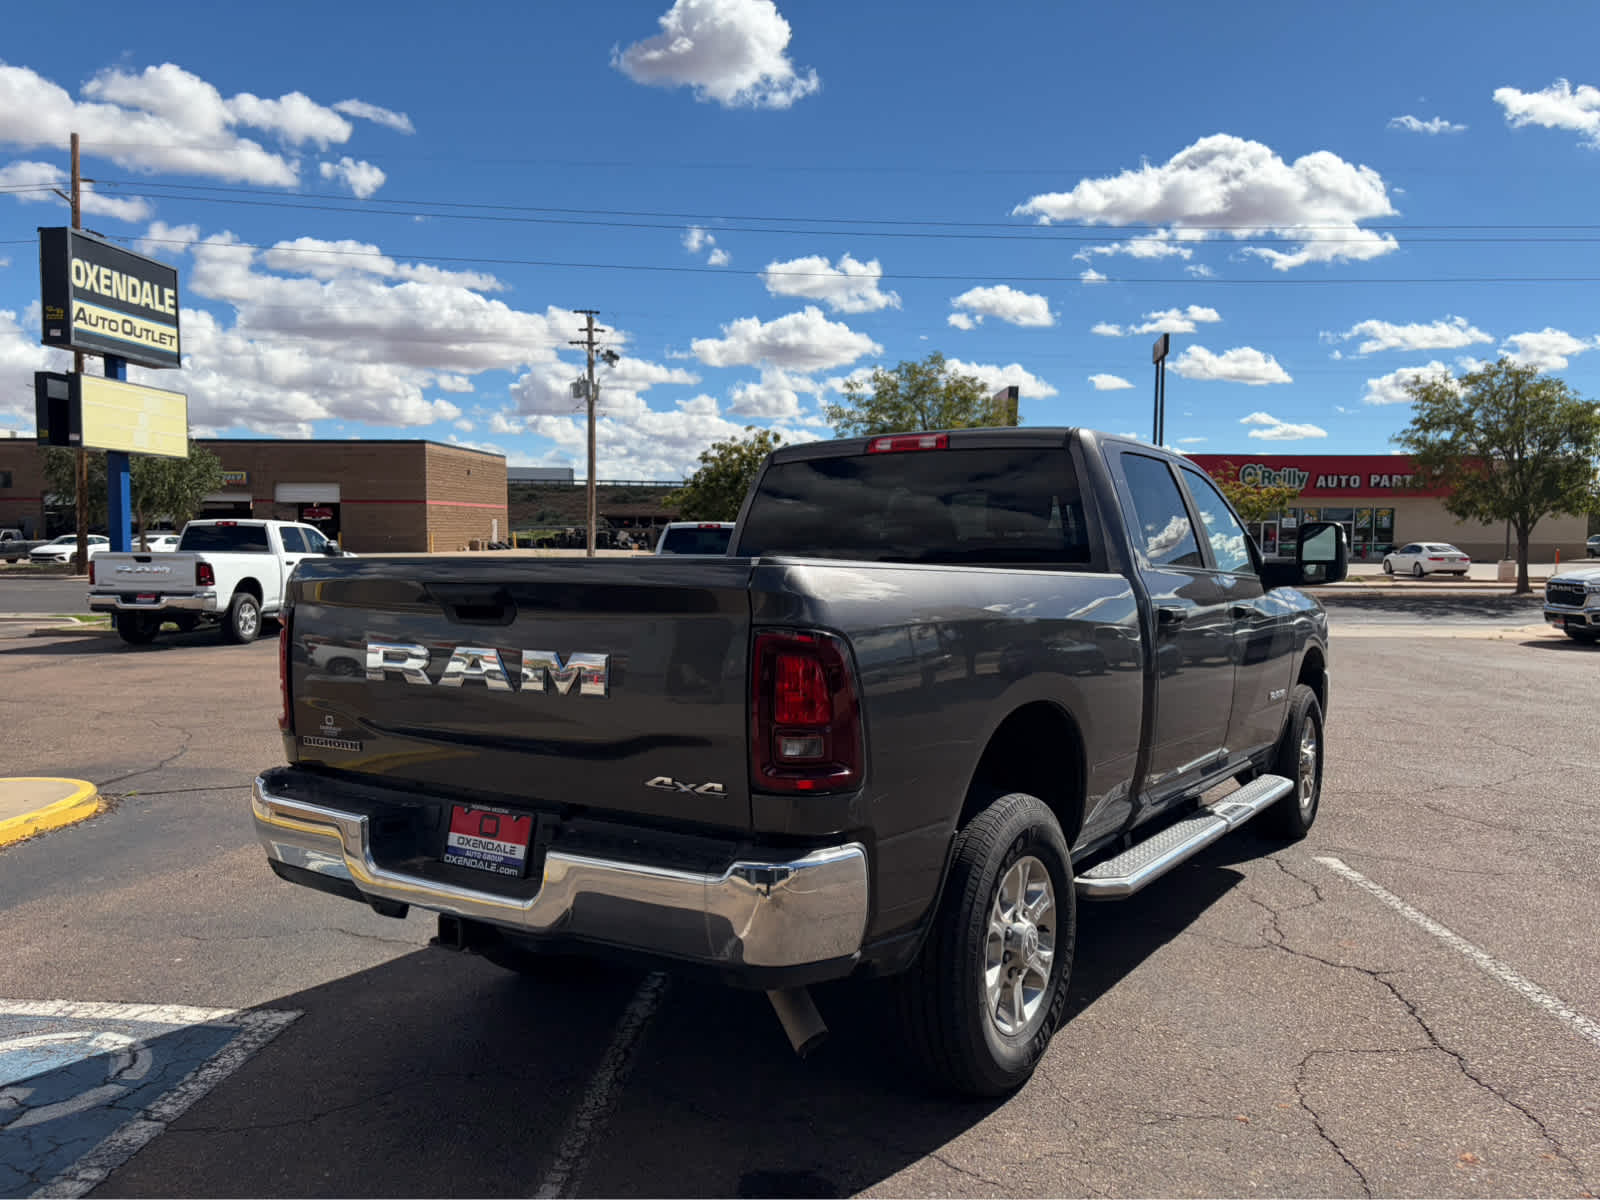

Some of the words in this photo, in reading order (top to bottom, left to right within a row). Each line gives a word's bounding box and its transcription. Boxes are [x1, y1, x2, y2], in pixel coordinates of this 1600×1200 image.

[72, 258, 176, 317] OXENDALE
[74, 307, 119, 333] AUTO
[122, 319, 176, 346] OUTLET
[1240, 464, 1309, 490] O'Reilly
[1316, 475, 1360, 489] AUTO
[1370, 474, 1424, 488] PART
[366, 641, 609, 698] RAM
[457, 836, 517, 856] OXENDALE
[465, 849, 481, 859] AUTO
[482, 852, 504, 863] GROUP
[443, 854, 518, 877] OXENDALE.com
